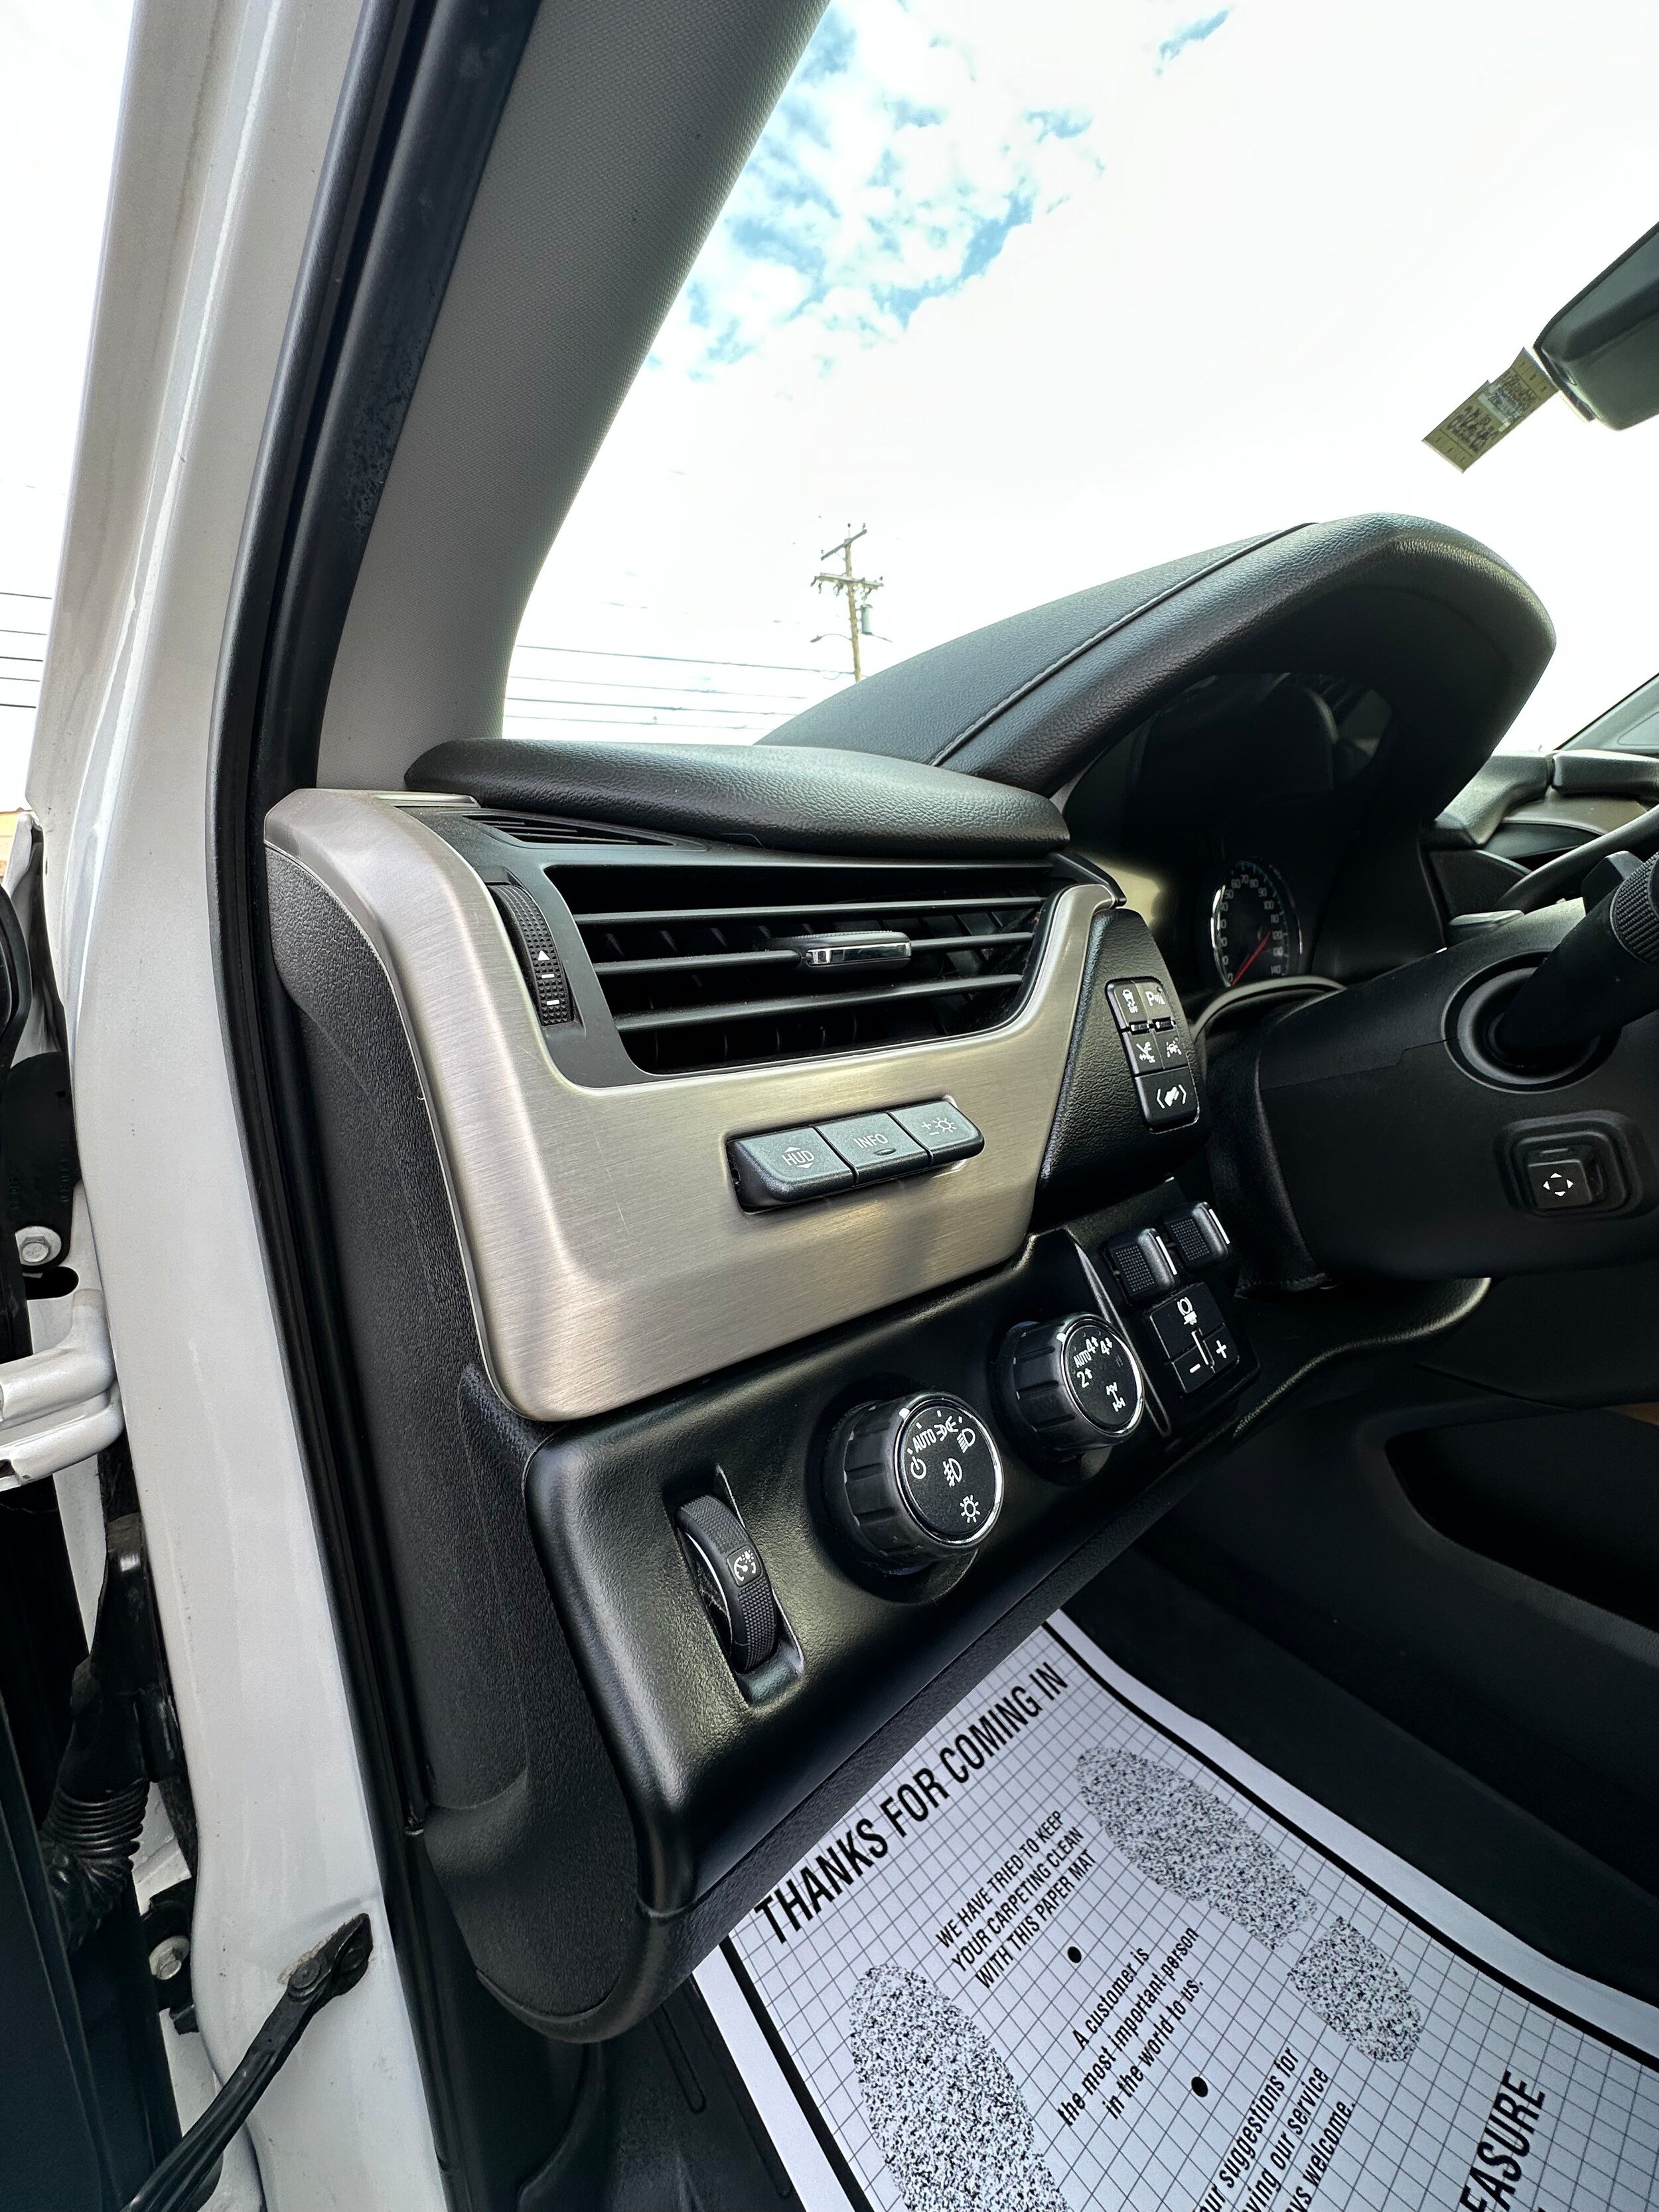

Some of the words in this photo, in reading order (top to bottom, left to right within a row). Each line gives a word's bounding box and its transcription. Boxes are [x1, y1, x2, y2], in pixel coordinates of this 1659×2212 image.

[781, 1149, 816, 1166] HUD
[853, 1133, 889, 1149] INFO
[1073, 1349, 1092, 1368] AUTO
[1076, 1370, 1090, 1388] 2
[912, 1428, 937, 1453] AUTO
[754, 1818, 889, 1944] THANKS
[879, 1767, 950, 1838] FOR
[939, 1685, 1043, 1783] COMING
[1029, 1661, 1070, 1701] IN
[935, 1919, 962, 1949] WE
[958, 1887, 992, 1926] HAVE
[986, 1854, 1025, 1895] TRIED
[1019, 1838, 1041, 1861] TO
[1034, 1810, 1064, 1850] KEEP
[952, 1928, 993, 1972] YOUR
[986, 1863, 1052, 1935] CARPETING
[1046, 1826, 1084, 1868] CLEAN
[974, 1945, 1013, 1990] WITH
[1006, 1915, 1040, 1953] THIS
[1033, 1875, 1076, 1922] PAPER
[1067, 1849, 1098, 1881] MAT
[1057, 2093, 1086, 2126] the
[1081, 2045, 1117, 2096] most
[1108, 1972, 1167, 2053] important
[1160, 1926, 1200, 1978] person
[1072, 2029, 1089, 2050] A
[1085, 1964, 1138, 2035] customer
[1130, 1947, 1150, 1967] is
[1102, 2095, 1125, 2120] in
[1116, 2065, 1144, 2098] the
[1137, 2014, 1175, 2068] world
[1166, 2000, 1187, 2022] to
[1181, 1978, 1204, 2002] us.
[1219, 2075, 1285, 2189] suggestions
[1273, 2047, 1299, 2079] for
[1242, 2168, 1282, 2212] ving
[1269, 2131, 1295, 2171] our
[1287, 2067, 1329, 2136] service
[1303, 2101, 1356, 2188] welcome.
